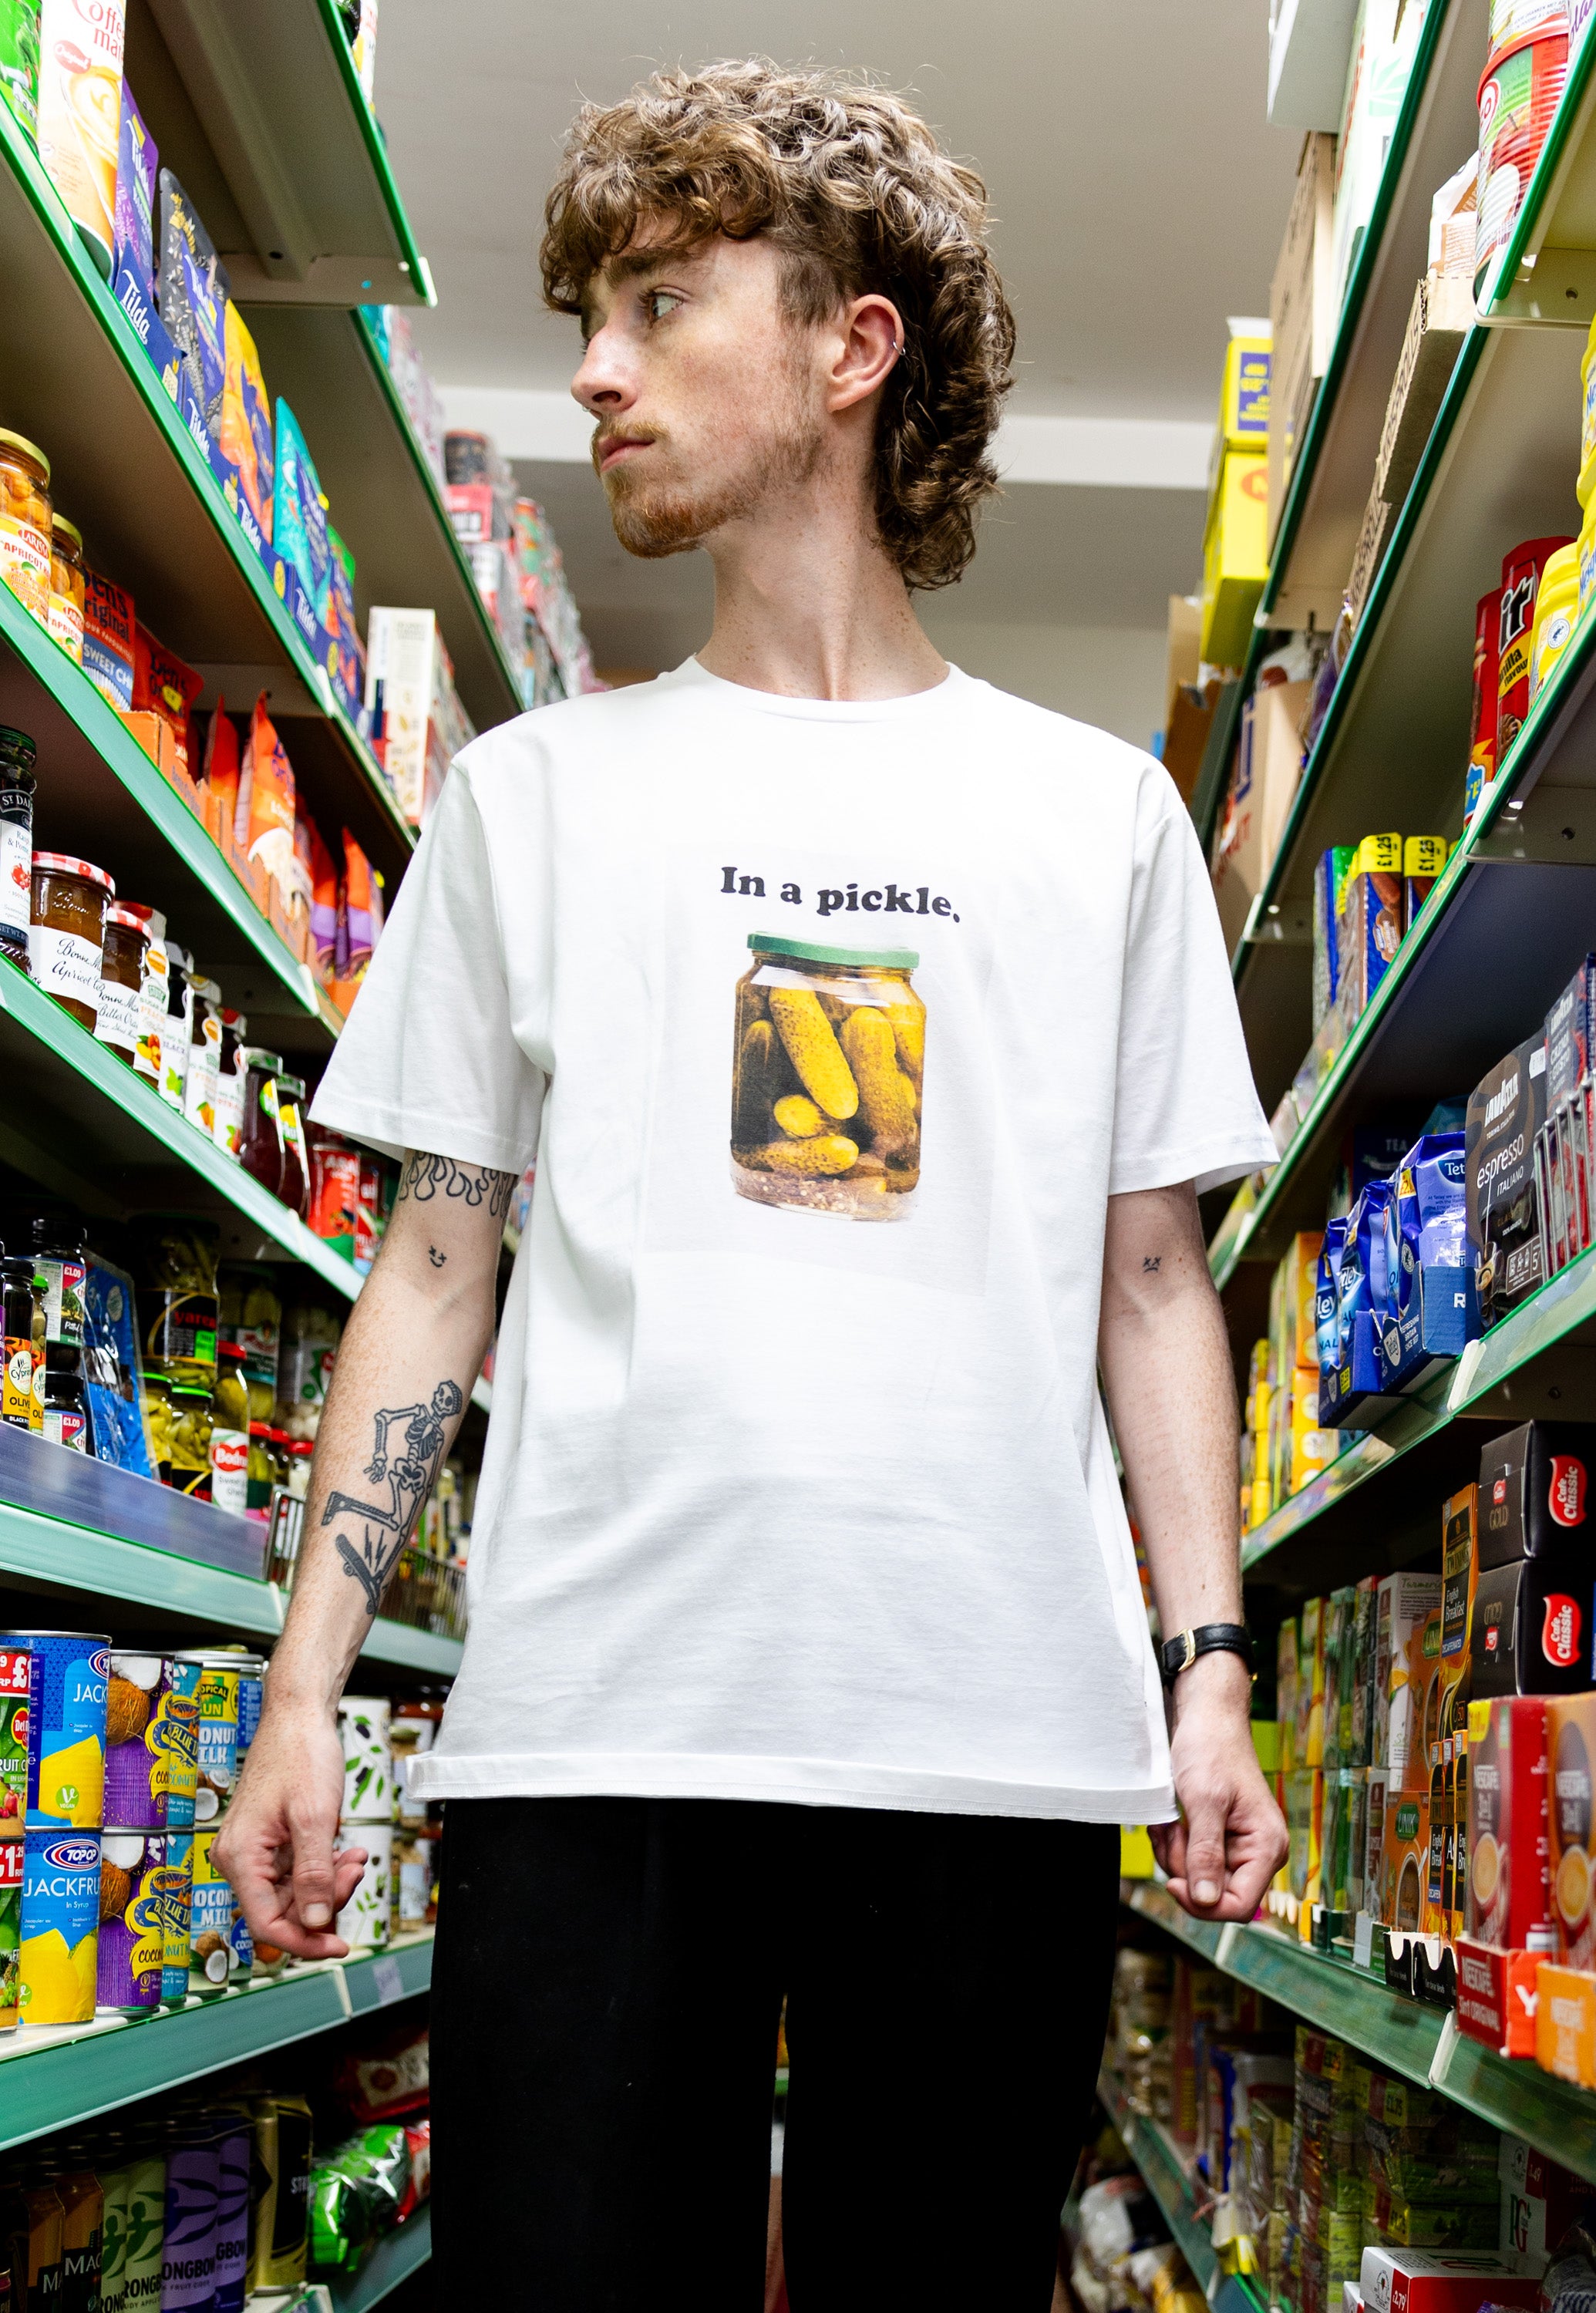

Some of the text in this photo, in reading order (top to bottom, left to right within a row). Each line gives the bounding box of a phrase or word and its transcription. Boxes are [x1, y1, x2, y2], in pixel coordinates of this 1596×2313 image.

[120, 269, 149, 345] Tilda
[187, 397, 211, 464] Tilda
[239, 497, 262, 557] Tilda
[4, 541, 42, 569] APRICOT
[83, 642, 116, 676] SWEET
[2, 794, 14, 806] ST
[1376, 835, 1392, 868] £1.25
[1419, 839, 1435, 872] £1.25
[721, 866, 961, 924] In a pickle.
[57, 936, 90, 965] Bonne
[51, 960, 92, 986] Apricot
[1483, 1072, 1520, 1128] LAVAZZA
[1386, 1138, 1408, 1153] TEA
[1476, 1133, 1525, 1190] espresso
[1497, 1165, 1524, 1198] ITALIANO
[63, 1265, 82, 1279] £1.09
[9, 1416, 25, 1425] BLACK
[62, 1416, 81, 1429] £1.09
[1557, 1477, 1567, 1503] Cafe
[1564, 1466, 1579, 1520] Classic
[1489, 1504, 1510, 1531] GOLD
[1446, 1586, 1460, 1604] English
[1445, 1600, 1466, 1622] Breakfast
[1551, 1616, 1561, 1642] Cafe
[1556, 1604, 1573, 1659] Classic
[1397, 1816, 1417, 1835] UNIK
[73, 1901, 89, 1911] Syrup
[170, 2279, 211, 2291] FRUIT CIDER
